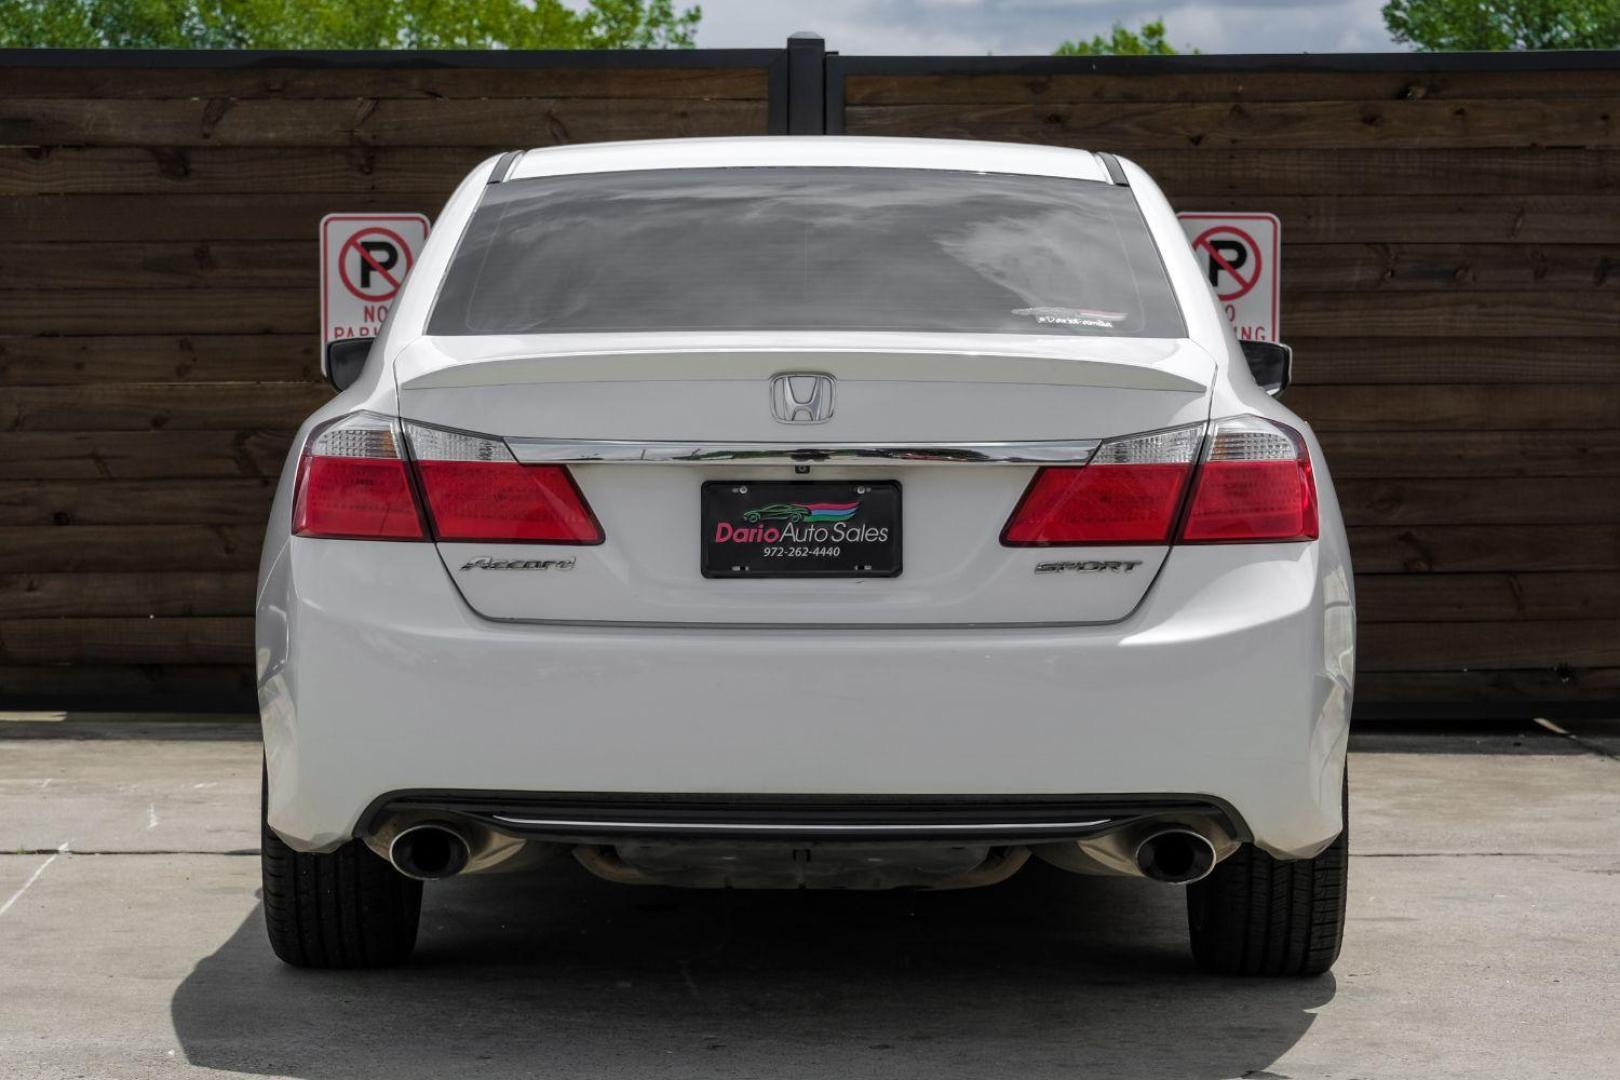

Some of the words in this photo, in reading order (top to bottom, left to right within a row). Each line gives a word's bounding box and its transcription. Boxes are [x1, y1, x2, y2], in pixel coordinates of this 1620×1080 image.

[360, 241, 399, 288] P
[1208, 240, 1248, 287] P
[364, 305, 389, 323] NO
[715, 521, 780, 544] Dario
[779, 521, 829, 543] Auto
[831, 521, 889, 543] Sales
[763, 546, 841, 558] 972-262-4440
[1034, 560, 1143, 574] SPORT
